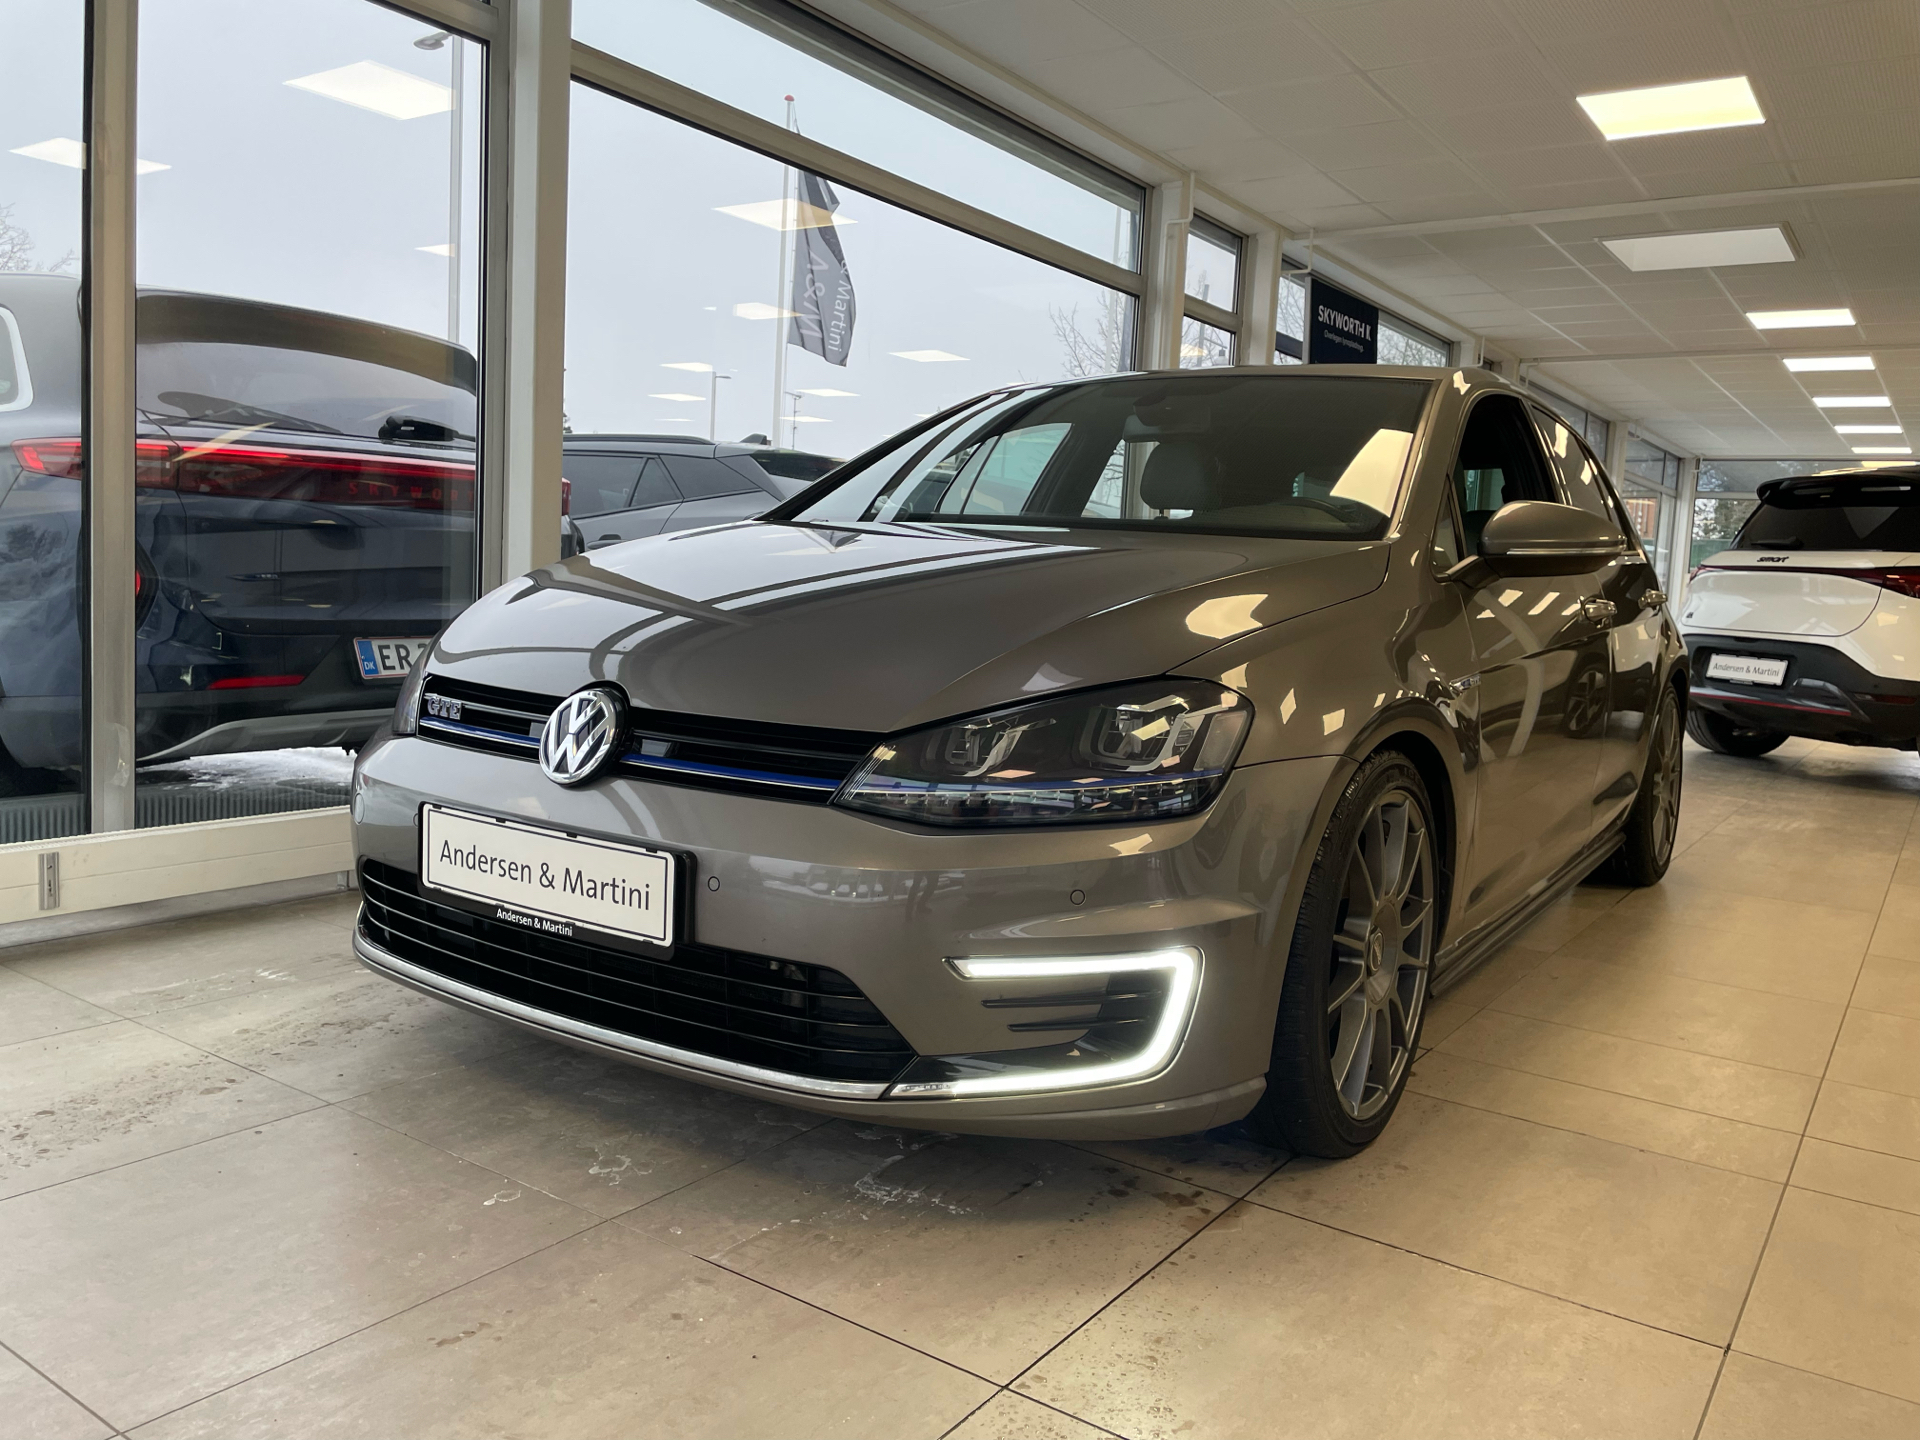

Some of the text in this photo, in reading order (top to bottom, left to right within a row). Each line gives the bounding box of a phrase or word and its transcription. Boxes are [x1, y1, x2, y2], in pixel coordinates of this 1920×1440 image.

[828, 280, 852, 352] Martini
[1318, 305, 1365, 338] SKYWORTH
[365, 661, 375, 670] DK
[1713, 663, 1780, 677] Andersen & Martini
[427, 697, 461, 720] GTE
[440, 839, 650, 911] Andersen & Martini
[496, 908, 573, 937] Andersen & Martini
